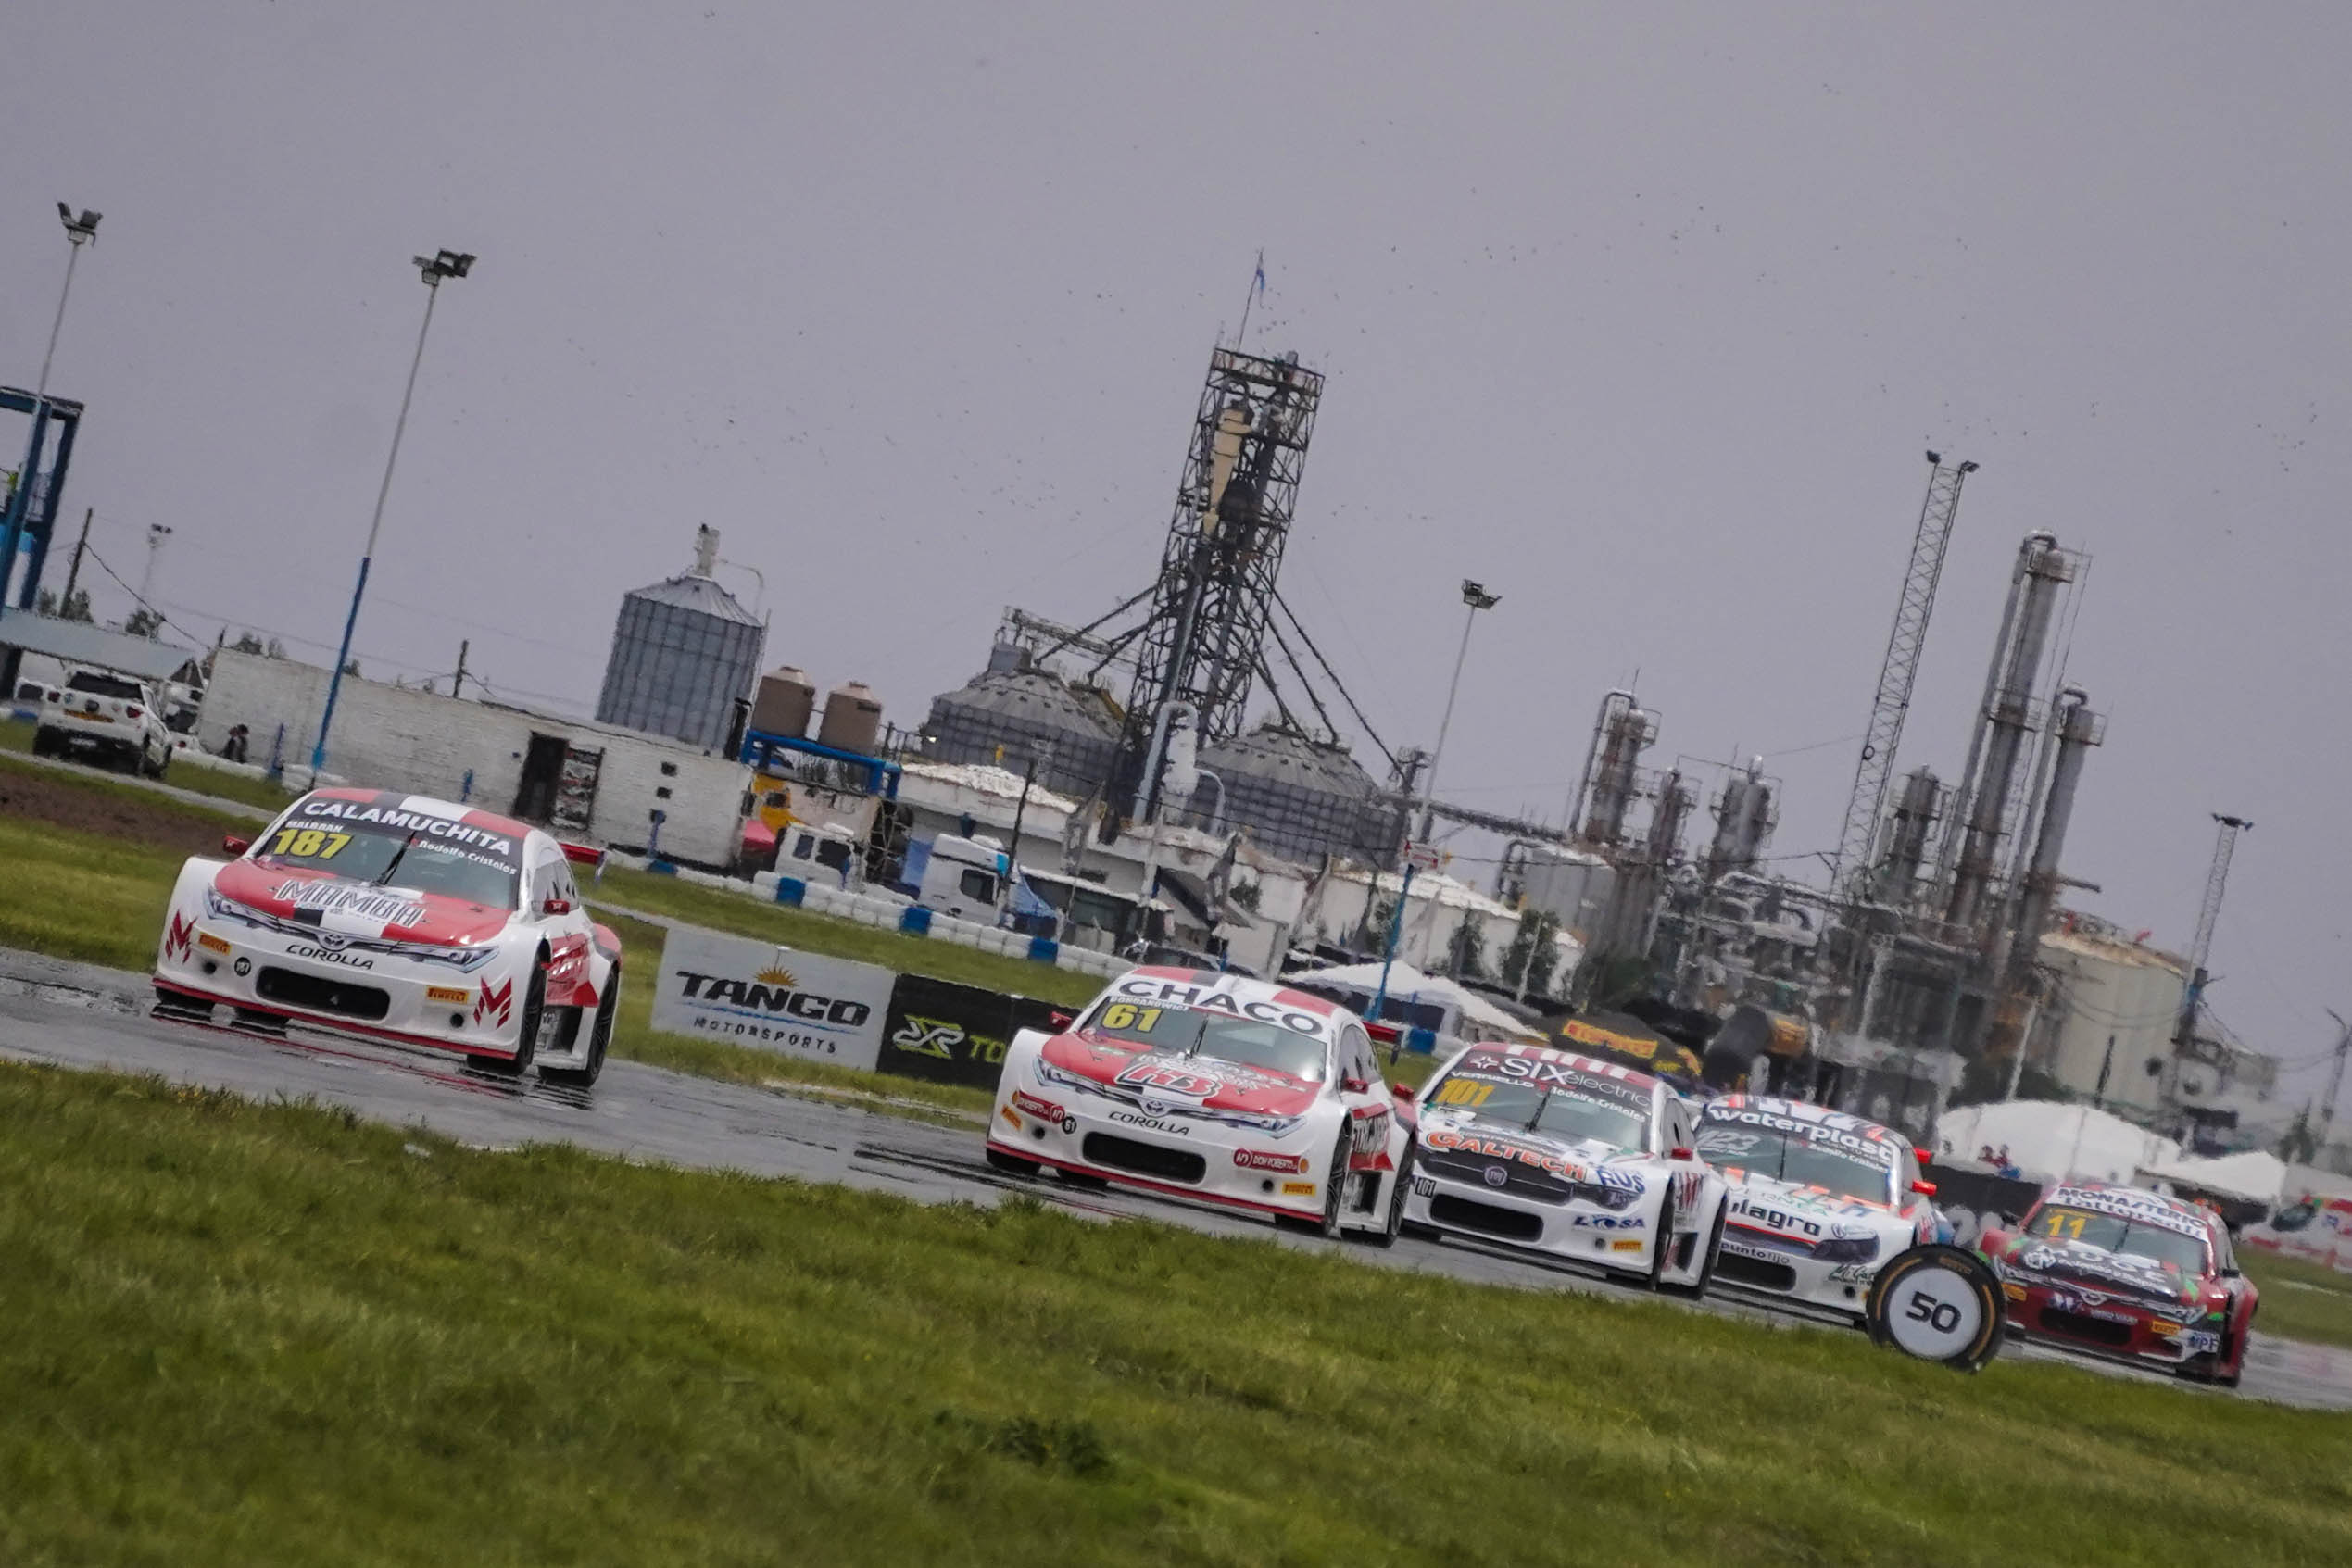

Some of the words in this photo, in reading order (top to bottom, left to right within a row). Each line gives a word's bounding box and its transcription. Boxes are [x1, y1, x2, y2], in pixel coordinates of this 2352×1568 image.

[273, 829, 354, 859] 187
[304, 803, 510, 856] CALAMUCHITA
[419, 840, 466, 859] Rodolfo
[467, 853, 518, 876] Cristales
[273, 879, 427, 930] MAMBA
[235, 960, 249, 974] 187
[285, 943, 375, 971] COROLLA
[676, 970, 871, 1028] TANGO
[1118, 980, 1323, 1035] CHACO
[1101, 1003, 1163, 1034] 61
[694, 1017, 836, 1054] MOTORSPORTS
[1436, 1078, 1496, 1108] 101
[1108, 1110, 1190, 1136] COROLLA
[1709, 1110, 1893, 1161] waterplast
[1427, 1131, 1590, 1183] GALTECH
[1416, 1178, 1435, 1197] 101
[1596, 1167, 1646, 1195] RUS
[2048, 1214, 2086, 1239] 11
[1905, 1290, 1963, 1335] 50
